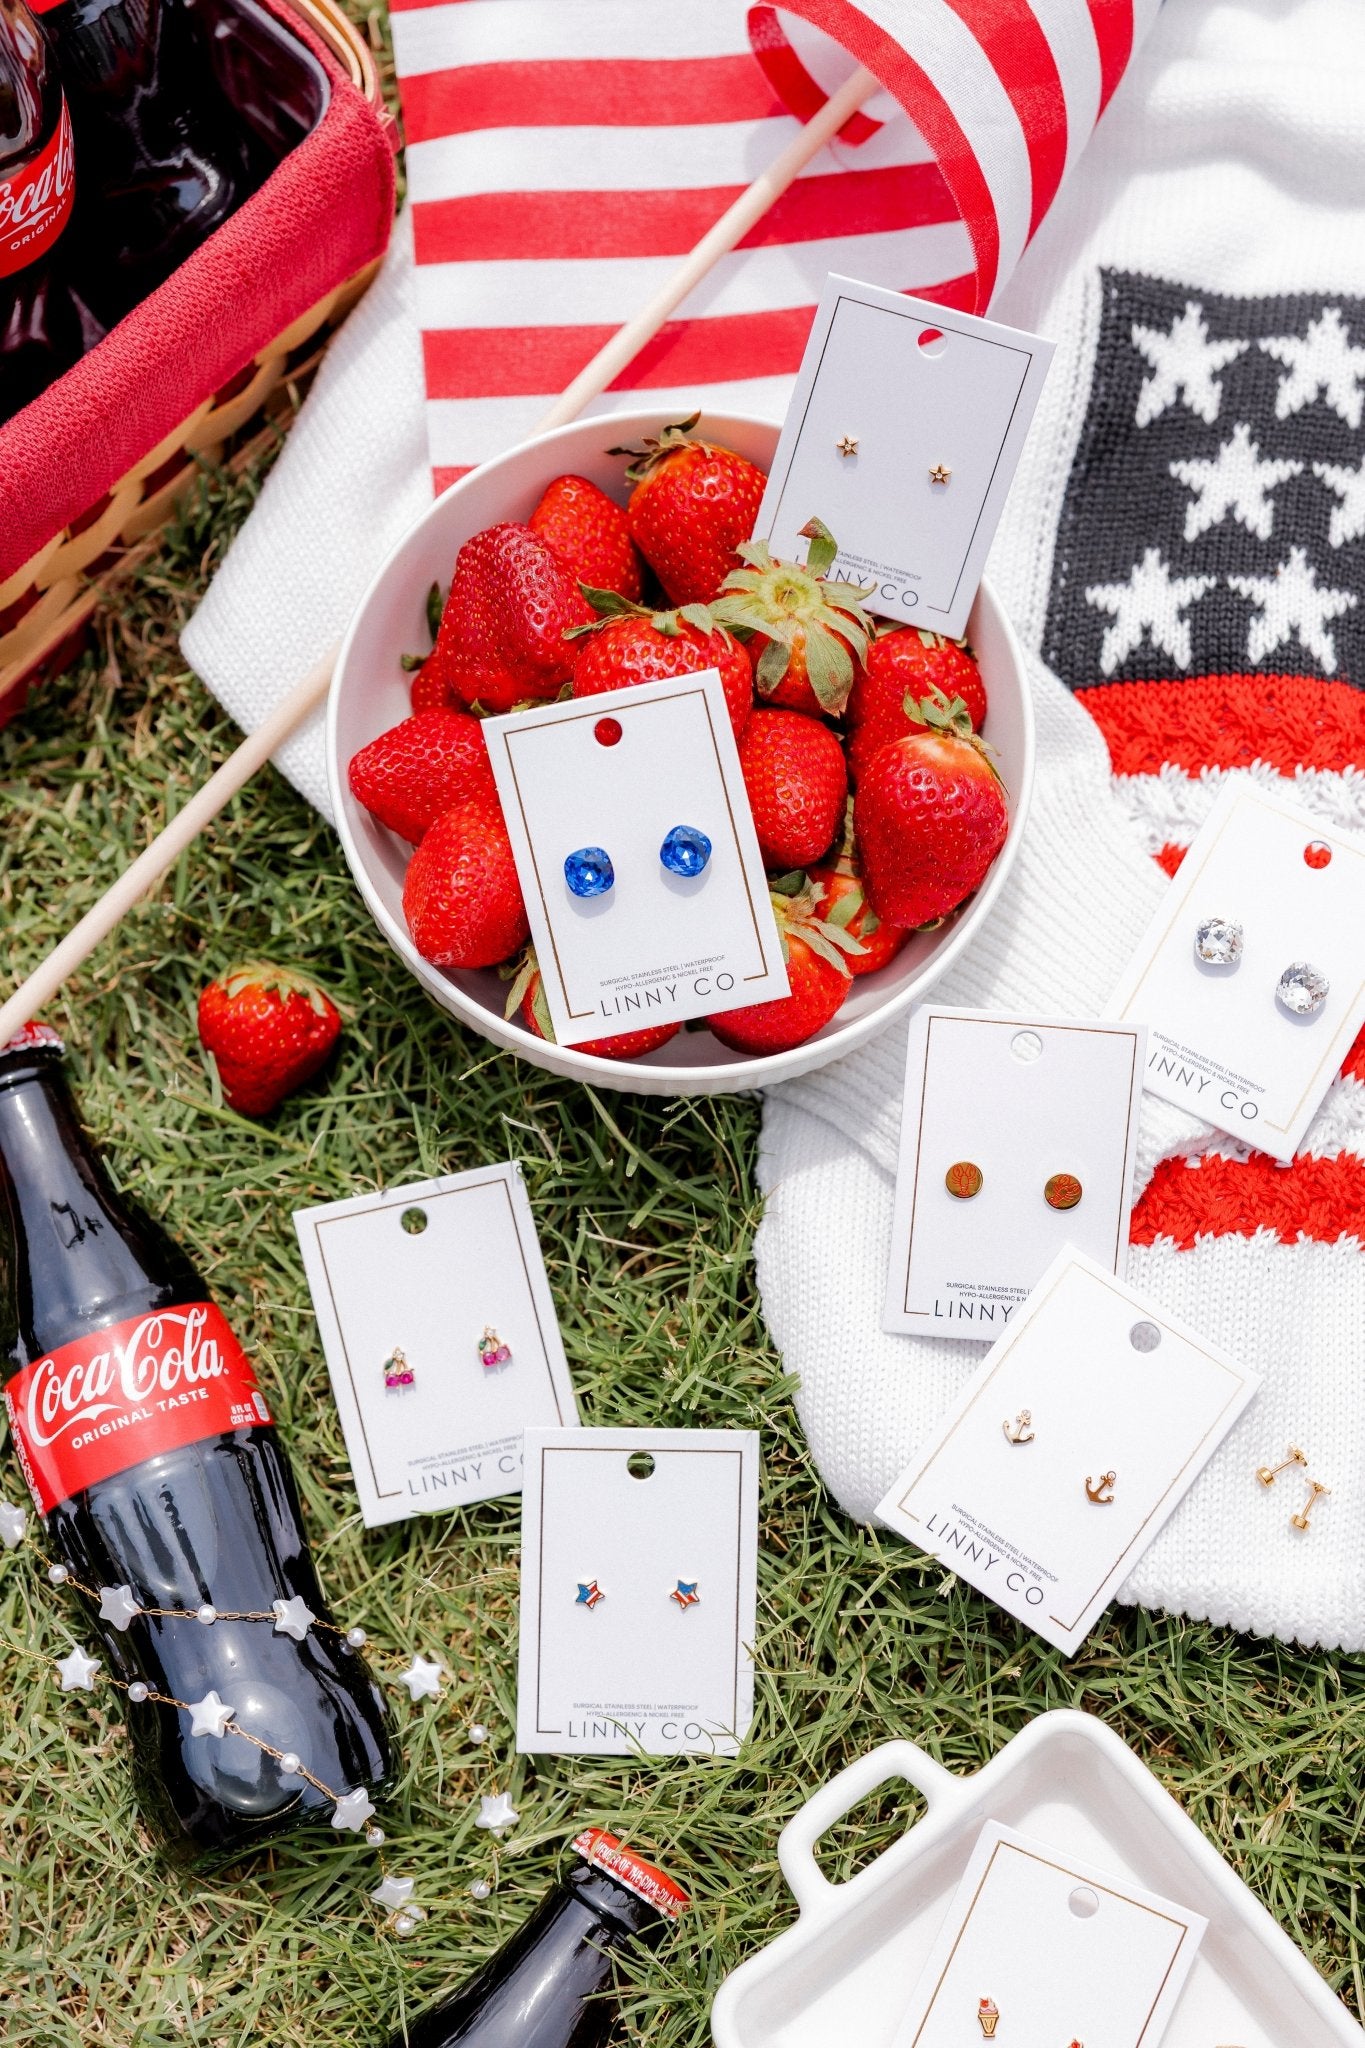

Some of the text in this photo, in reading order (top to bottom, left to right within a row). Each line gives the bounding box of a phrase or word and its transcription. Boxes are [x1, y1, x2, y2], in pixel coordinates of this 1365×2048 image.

[10, 197, 67, 250] ORIGINAL
[837, 550, 863, 563] TAINLESS
[863, 558, 879, 568] STEEL
[883, 565, 922, 580] WATERPROOF
[873, 570, 893, 580] NICKEL
[894, 576, 907, 584] FREE
[881, 583, 919, 606] CO
[600, 976, 630, 987] SURGICAL
[631, 968, 662, 980] STAINLESS
[662, 965, 680, 974] STEEL
[684, 954, 725, 969] WATERPROOF
[615, 975, 671, 992] HYPO-ALLERGENIC
[677, 968, 698, 979] NICKEL
[699, 965, 714, 973] FREE
[600, 973, 734, 1017] LINNY CO
[1153, 1031, 1180, 1050] SURGICAL
[1181, 1046, 1209, 1064] STAINLESS
[1209, 1060, 1225, 1073] STEEL
[1228, 1070, 1266, 1094] WATERPROOF
[1162, 1044, 1212, 1075] HYPO-ALLERGENIC
[1217, 1074, 1236, 1089] NICKEL
[1236, 1083, 1250, 1095] FREE
[1220, 1091, 1258, 1119] CO
[946, 1282, 977, 1291] SURGICAL
[977, 1284, 1008, 1293] STAINLESS
[1009, 1287, 1027, 1295] STEEL
[959, 1291, 1015, 1302] HYPO-ALLERGENIC
[935, 1299, 1013, 1323] LINNY
[71, 1387, 209, 1450] ORIGINAL TASTE
[230, 1405, 237, 1415] 8
[408, 1453, 523, 1496] LINNY C
[951, 1503, 978, 1526] SURGICAL
[977, 1521, 1005, 1545] STAINLESS
[1004, 1541, 1020, 1558] STEEL
[1022, 1554, 1059, 1583] WATERPROOF
[958, 1518, 1006, 1556] HYPO-ALLERGENIC
[1010, 1556, 1029, 1574] NICKEL
[1029, 1570, 1043, 1582] FREE
[926, 1513, 1044, 1605] LINNY CO
[568, 1721, 702, 1740] LINNY CO
[619, 1857, 631, 1871] OF
[627, 1864, 644, 1884] THE
